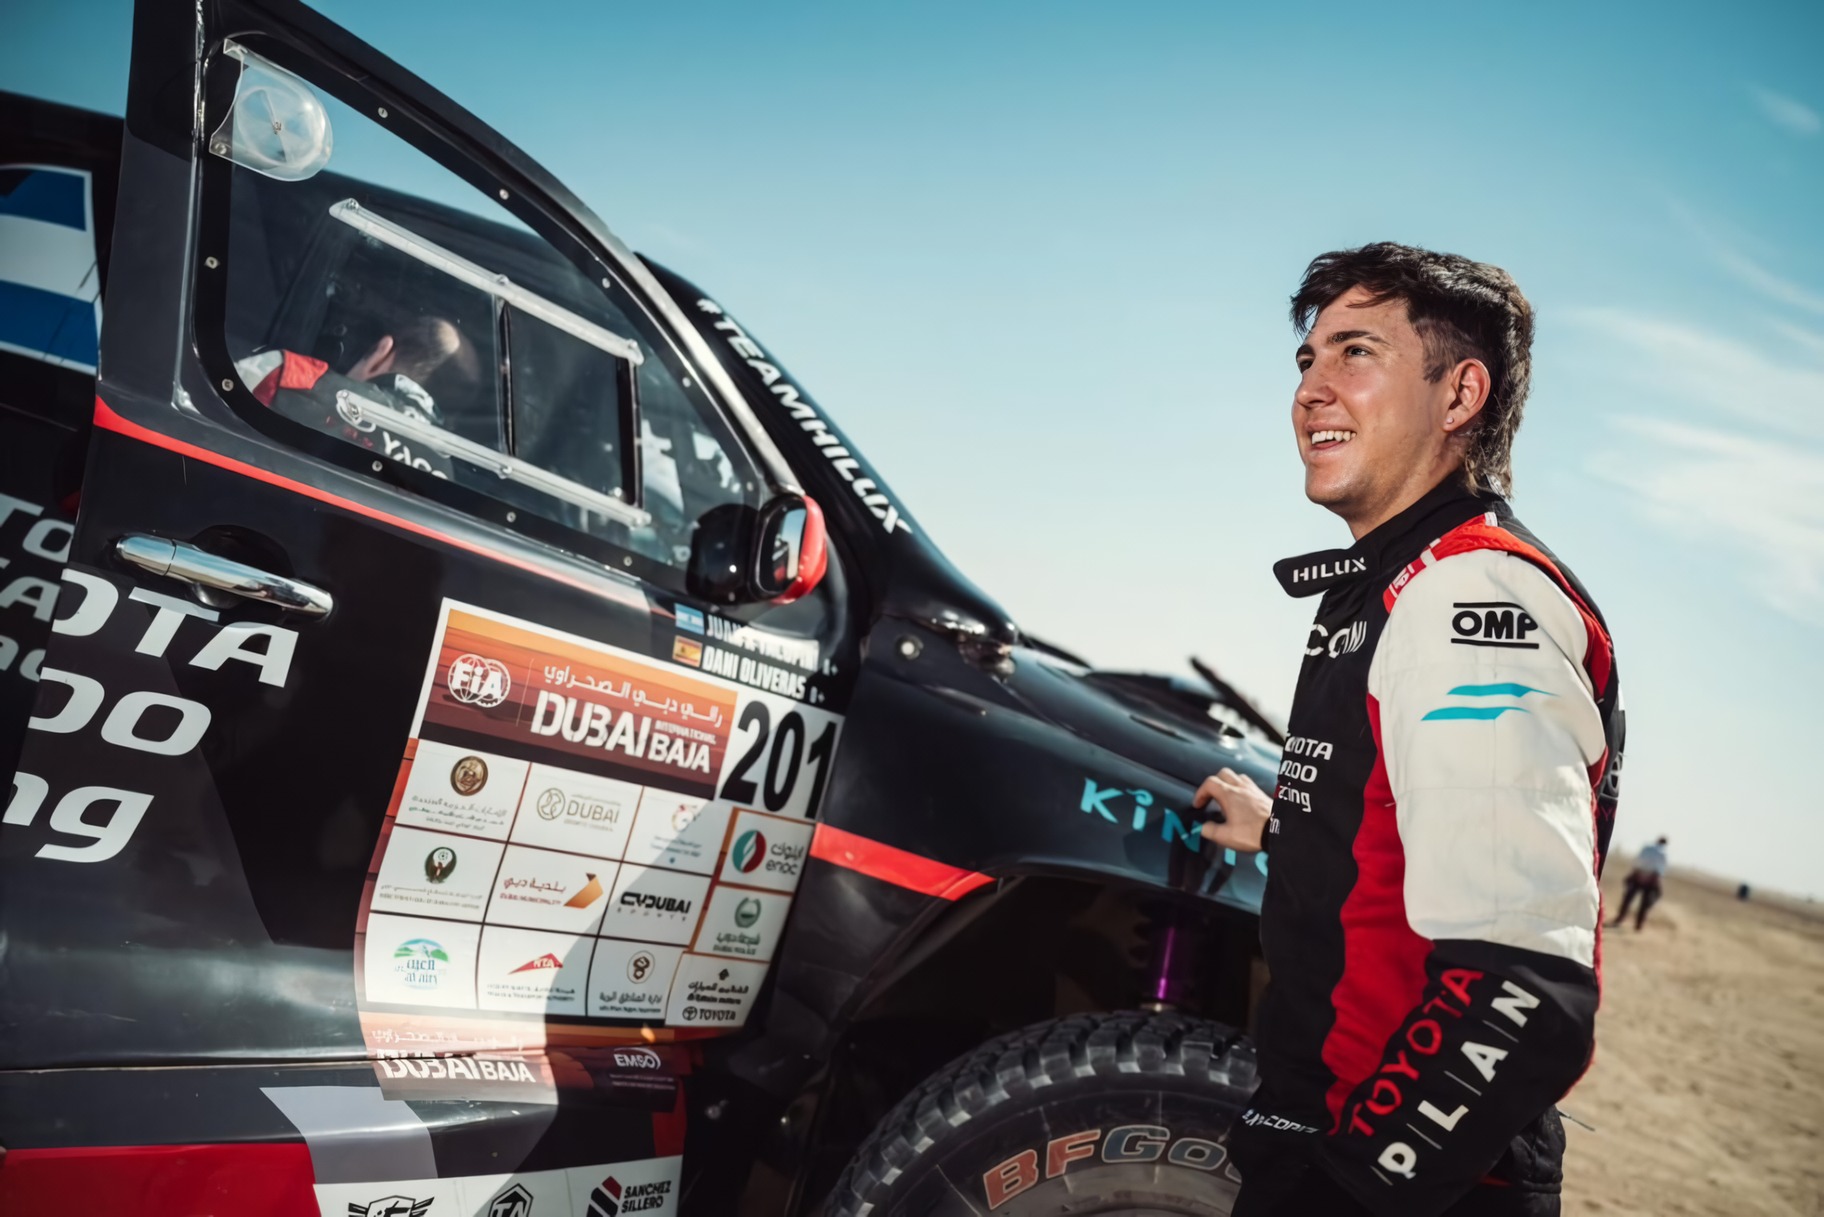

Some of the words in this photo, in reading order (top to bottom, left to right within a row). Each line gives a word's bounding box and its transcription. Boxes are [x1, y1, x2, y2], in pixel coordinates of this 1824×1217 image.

[1293, 557, 1367, 583] HILUX
[1452, 610, 1539, 640] OMP
[702, 645, 740, 679] DANI
[739, 656, 807, 699] OLIVERAS
[530, 689, 652, 759] DUBAI
[648, 732, 711, 774] BAJA
[719, 700, 838, 819] 201
[566, 799, 620, 825] DUBAI
[699, 1009, 736, 1021] TOYOTA
[1348, 967, 1485, 1138] TOYOTA
[478, 1060, 537, 1083] BAJA
[983, 1124, 1242, 1210] BFGo
[623, 1180, 671, 1199] SANCHEZ
